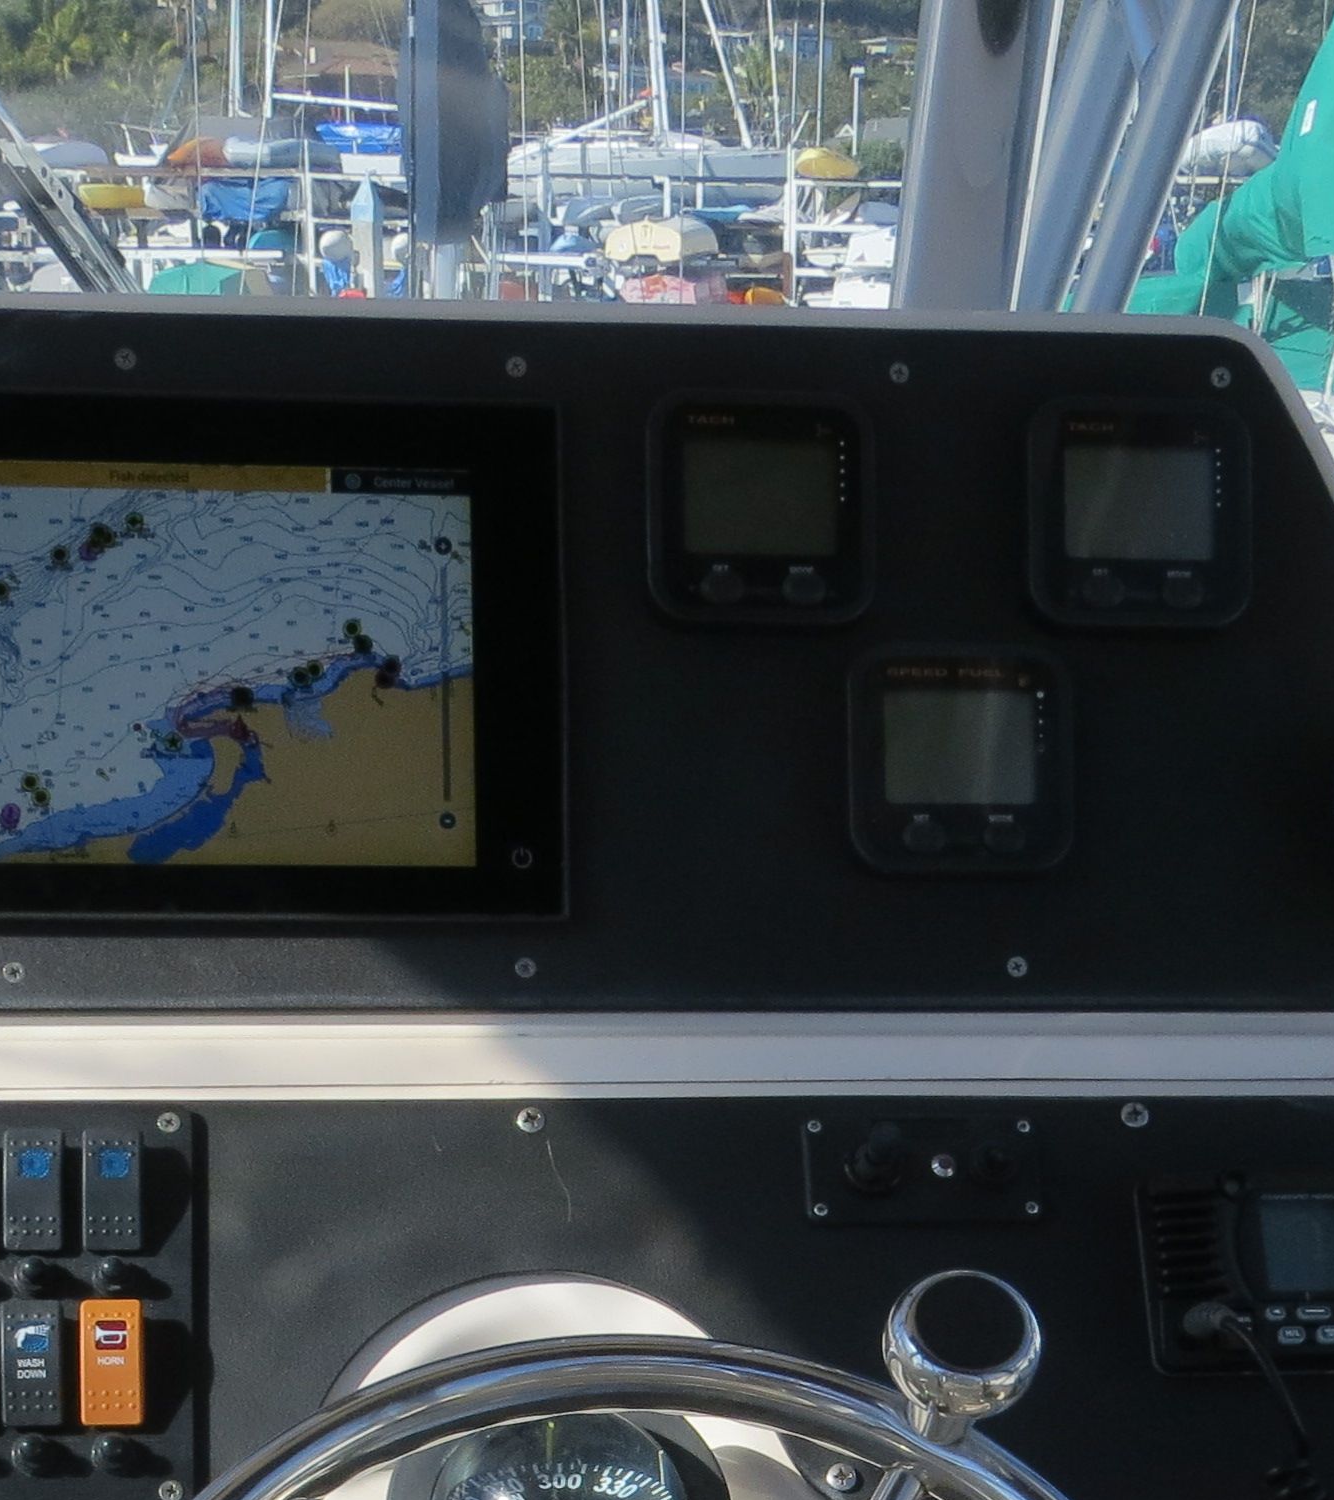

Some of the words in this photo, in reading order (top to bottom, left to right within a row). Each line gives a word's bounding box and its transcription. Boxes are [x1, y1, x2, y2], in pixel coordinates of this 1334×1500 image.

[687, 414, 735, 425] TACH
[1068, 421, 1115, 432] TACH
[886, 665, 947, 678] SPEED
[958, 666, 1004, 679] FUEL
[17, 1358, 45, 1369] WASH
[97, 1356, 125, 1367] HORN
[17, 1369, 47, 1380] DOWN
[538, 1473, 582, 1490] 300
[593, 1477, 638, 1499] 330
